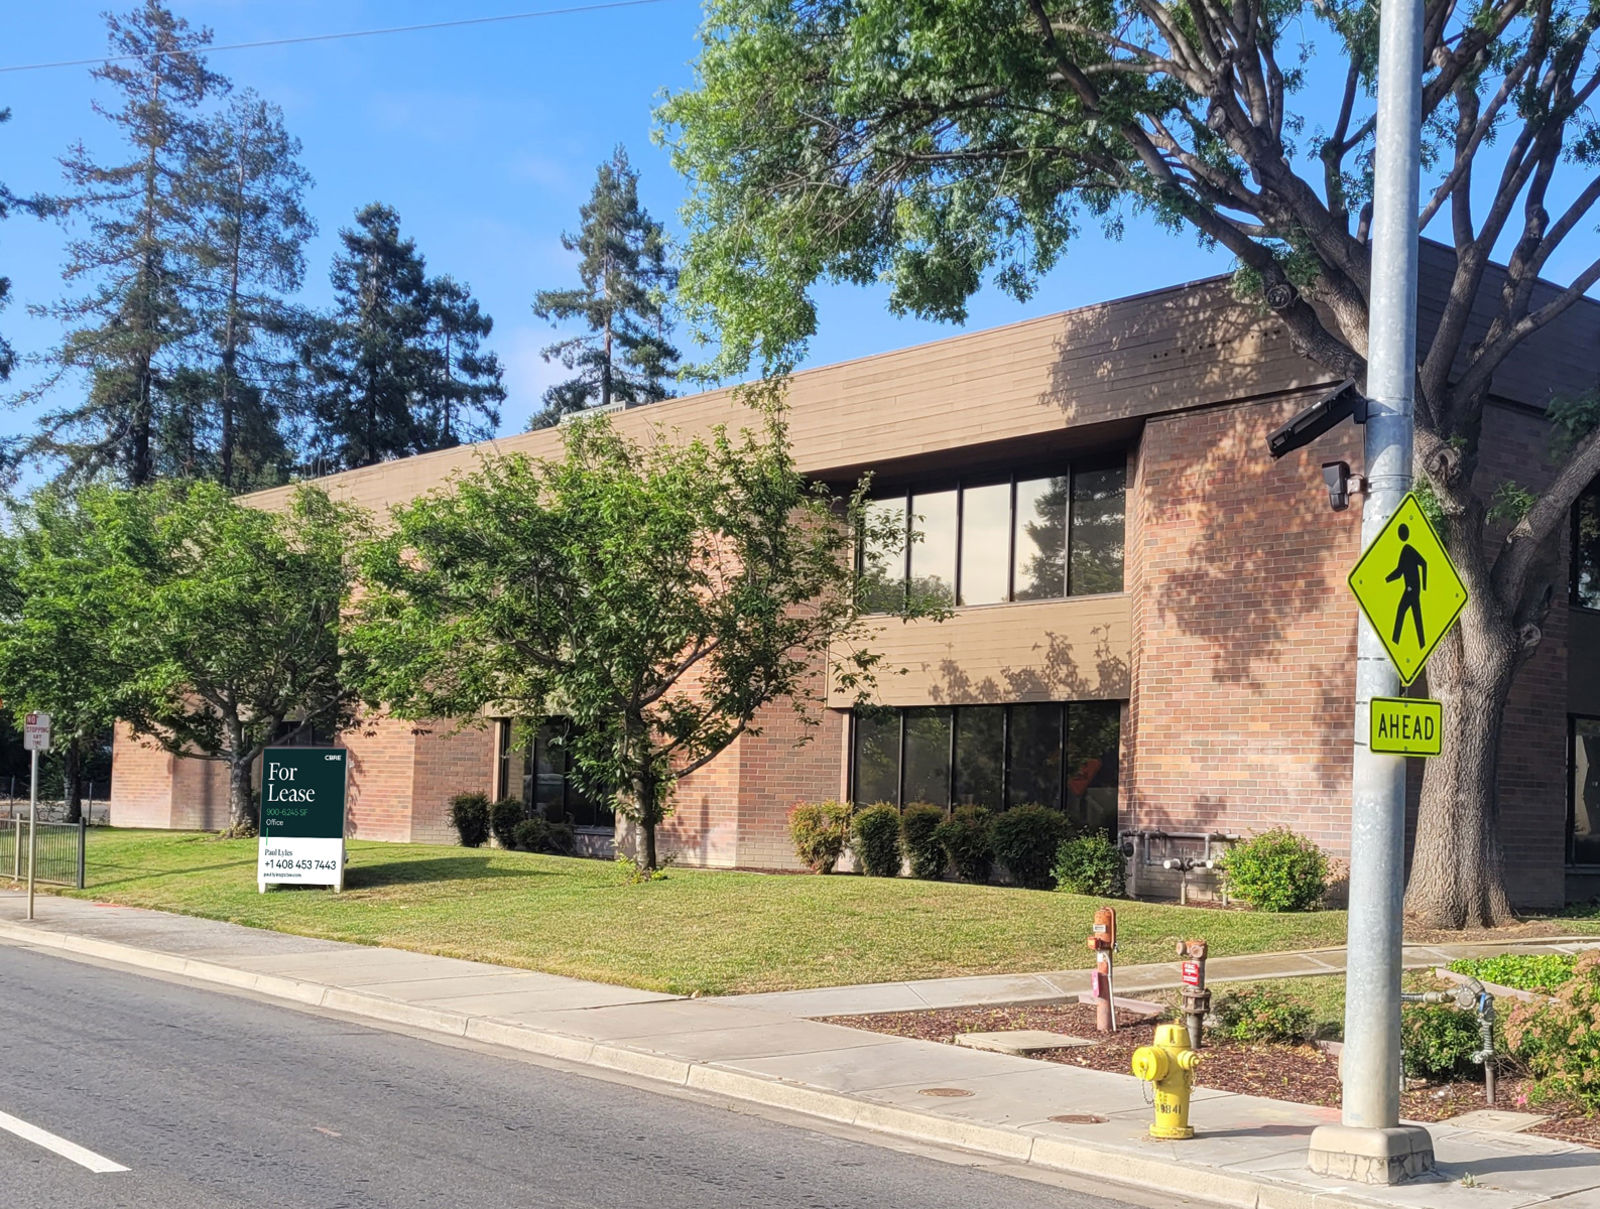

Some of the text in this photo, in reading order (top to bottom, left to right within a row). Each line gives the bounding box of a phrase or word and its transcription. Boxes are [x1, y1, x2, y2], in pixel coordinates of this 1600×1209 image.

[27, 715, 36, 724] NO
[1377, 713, 1434, 741] AHEAD
[268, 762, 298, 781] For
[267, 783, 316, 803] Lease
[300, 808, 308, 817] SF
[265, 818, 284, 826] Office
[264, 848, 293, 857] Paul Lyles
[264, 859, 337, 871] +1 408 453 7443
